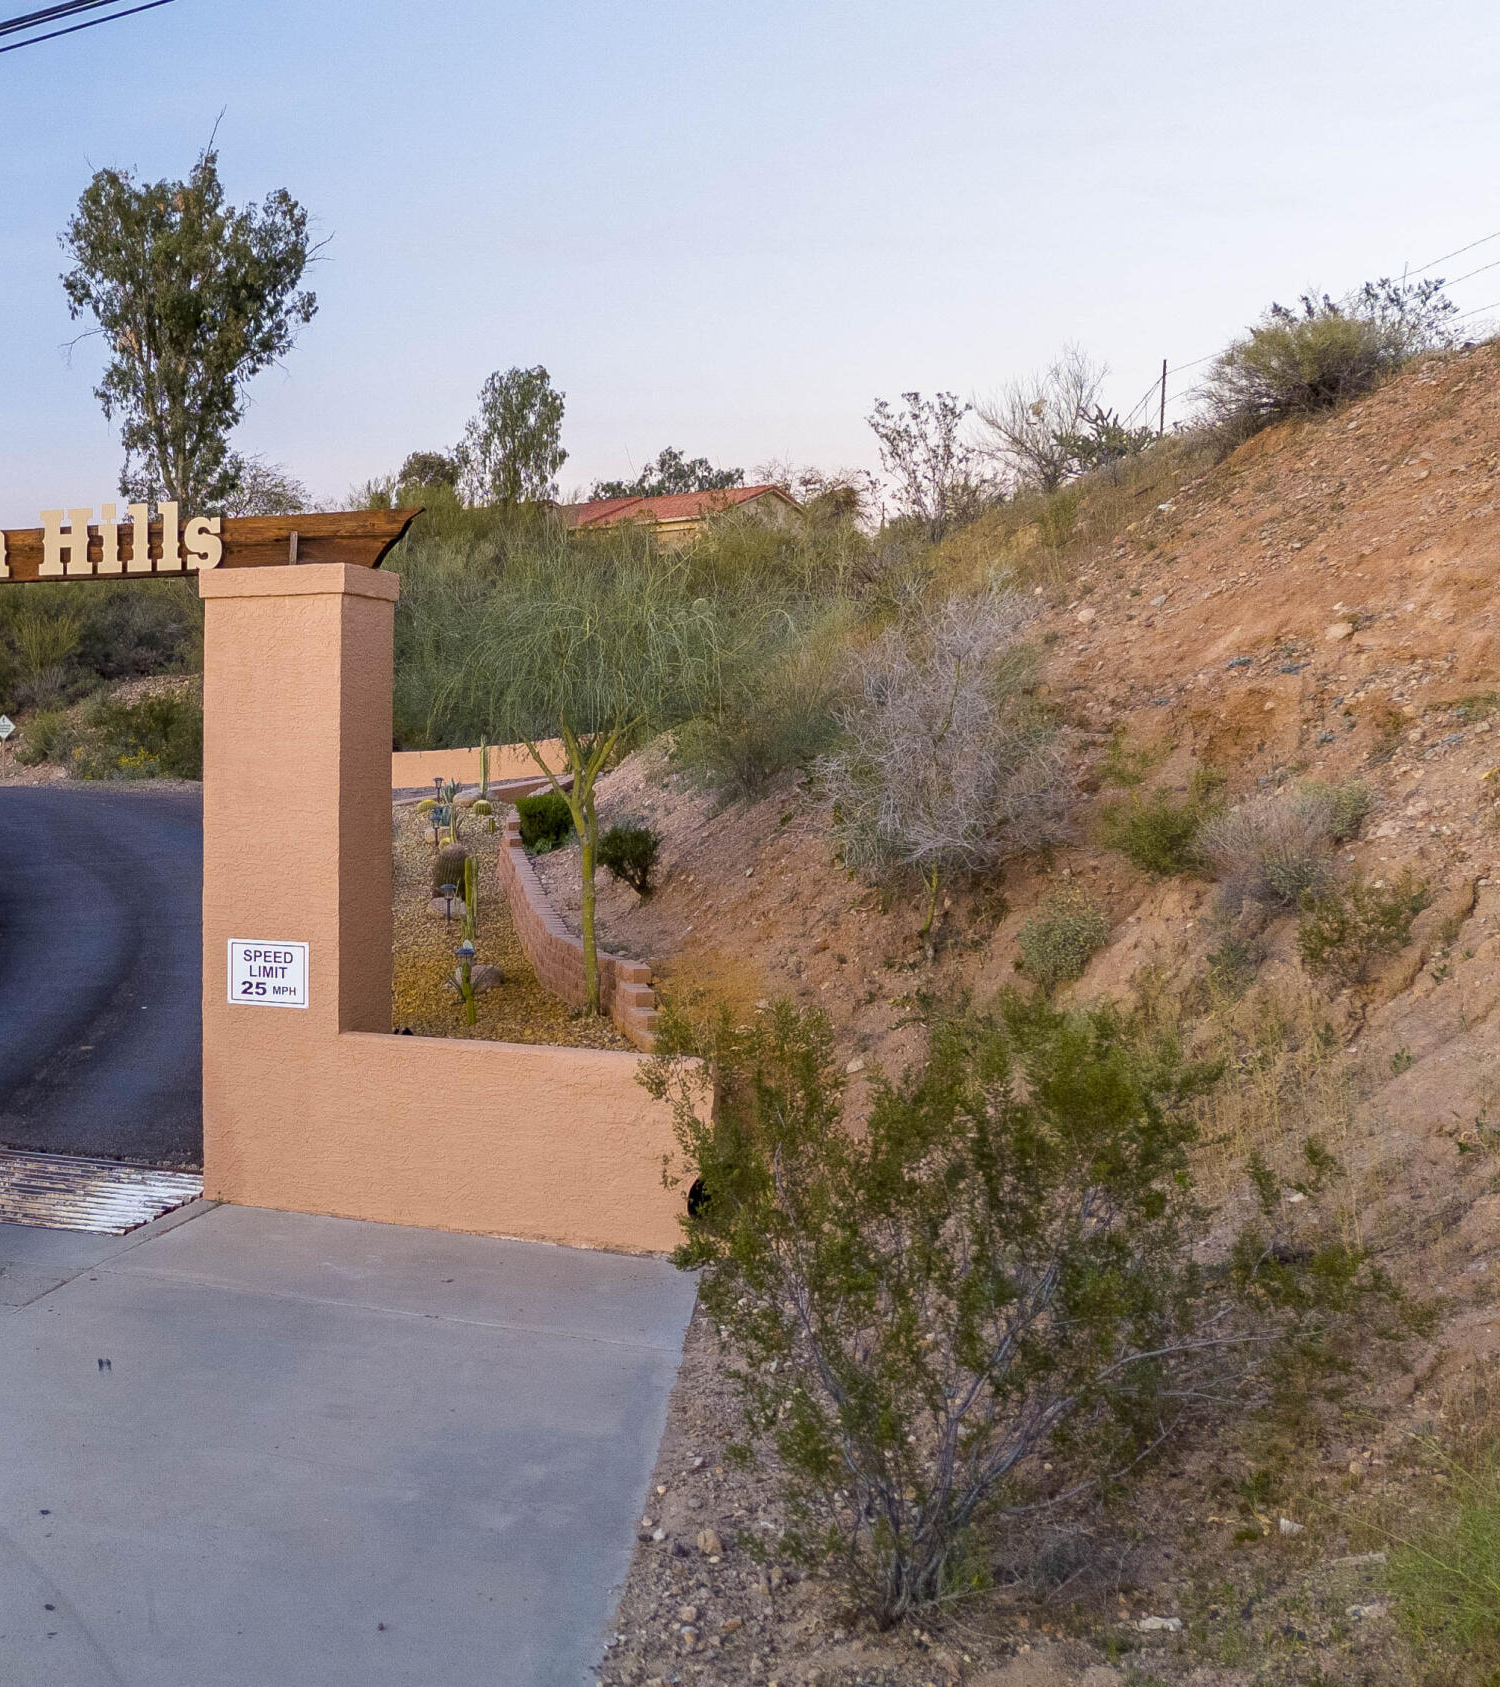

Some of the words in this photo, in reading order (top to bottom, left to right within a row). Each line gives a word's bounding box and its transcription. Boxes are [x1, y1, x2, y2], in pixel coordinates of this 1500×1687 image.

[38, 501, 224, 577] Hills
[243, 949, 293, 964] SPEED
[249, 965, 288, 979] LIMIT
[241, 981, 267, 996] 25
[272, 986, 296, 996] MPH
